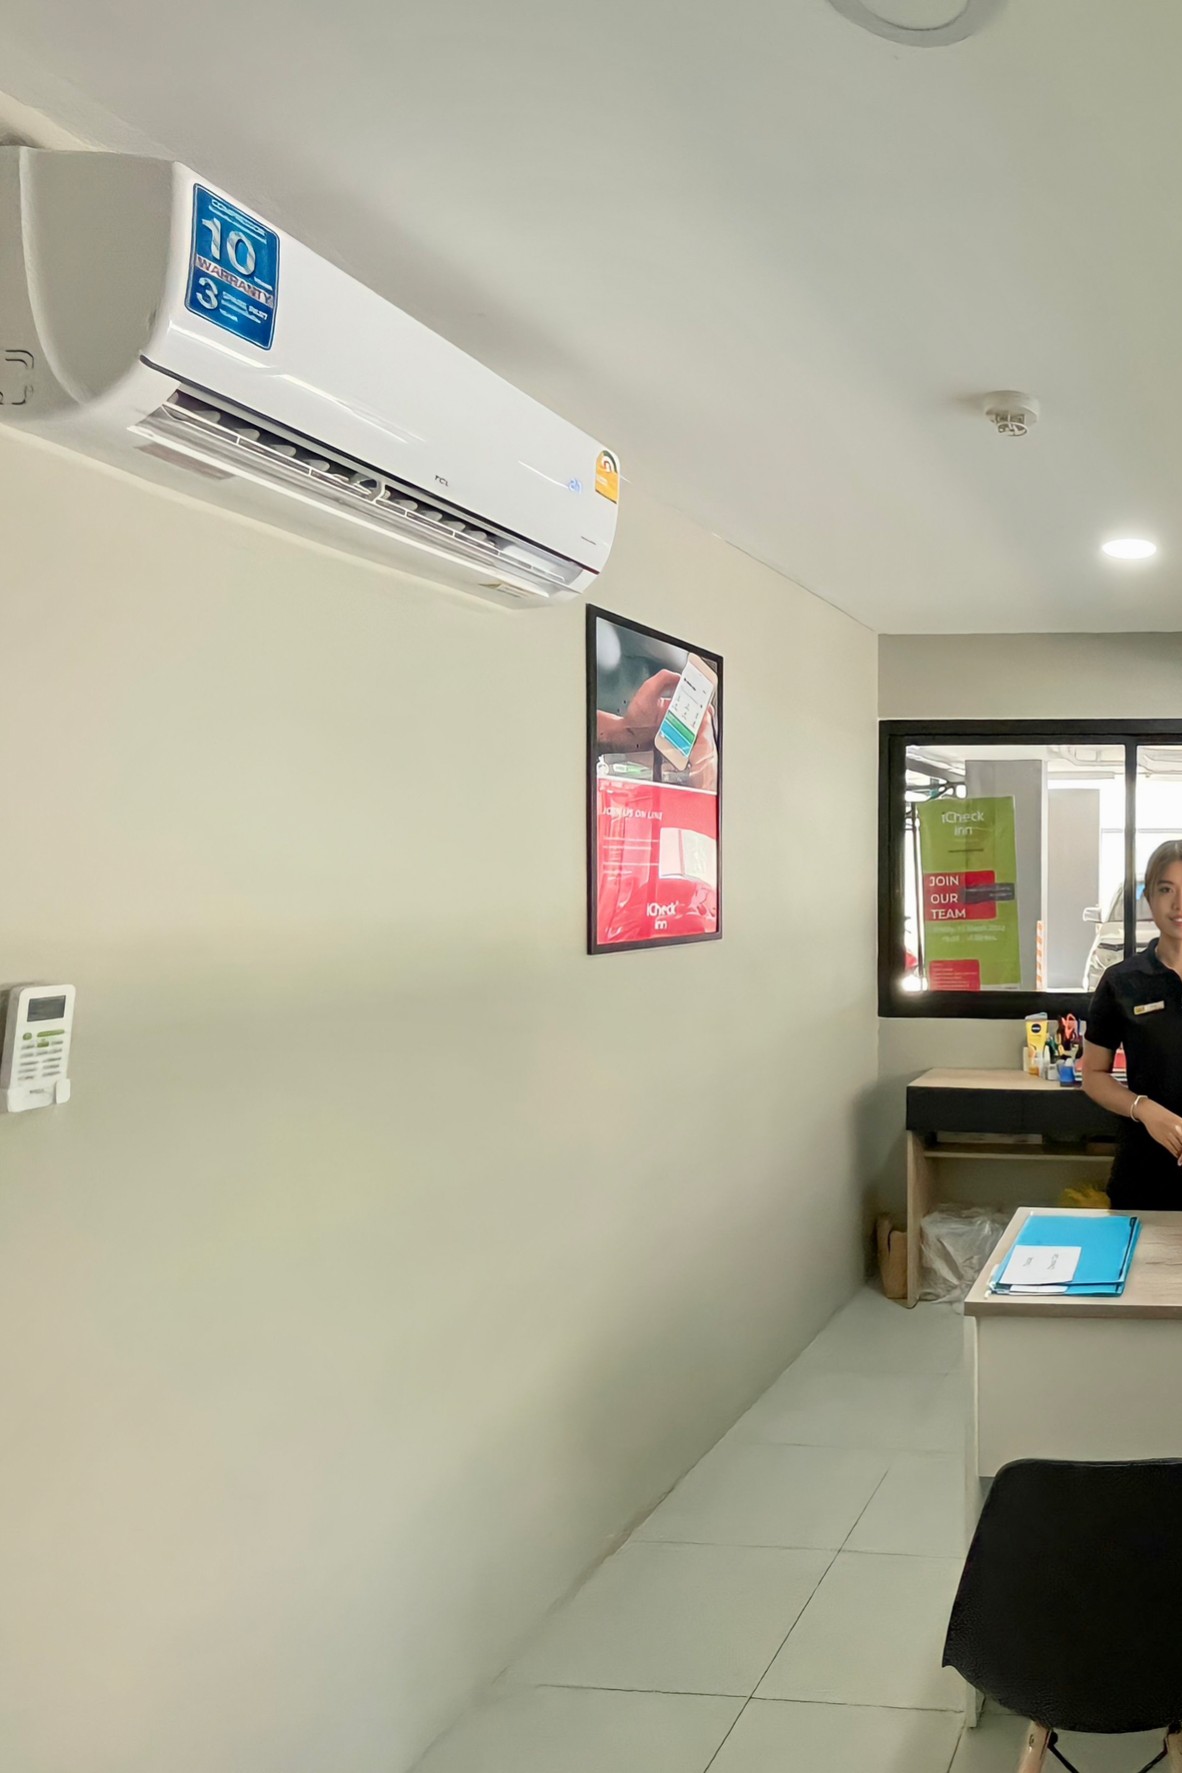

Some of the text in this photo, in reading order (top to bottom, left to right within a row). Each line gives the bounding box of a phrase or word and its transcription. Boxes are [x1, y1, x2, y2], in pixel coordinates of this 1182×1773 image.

[201, 217, 256, 276] 10
[196, 256, 273, 304] WARRANTY
[195, 277, 219, 310] 3
[929, 876, 960, 887] JOIN
[930, 892, 958, 904] OUR
[931, 909, 967, 920] TEAM
